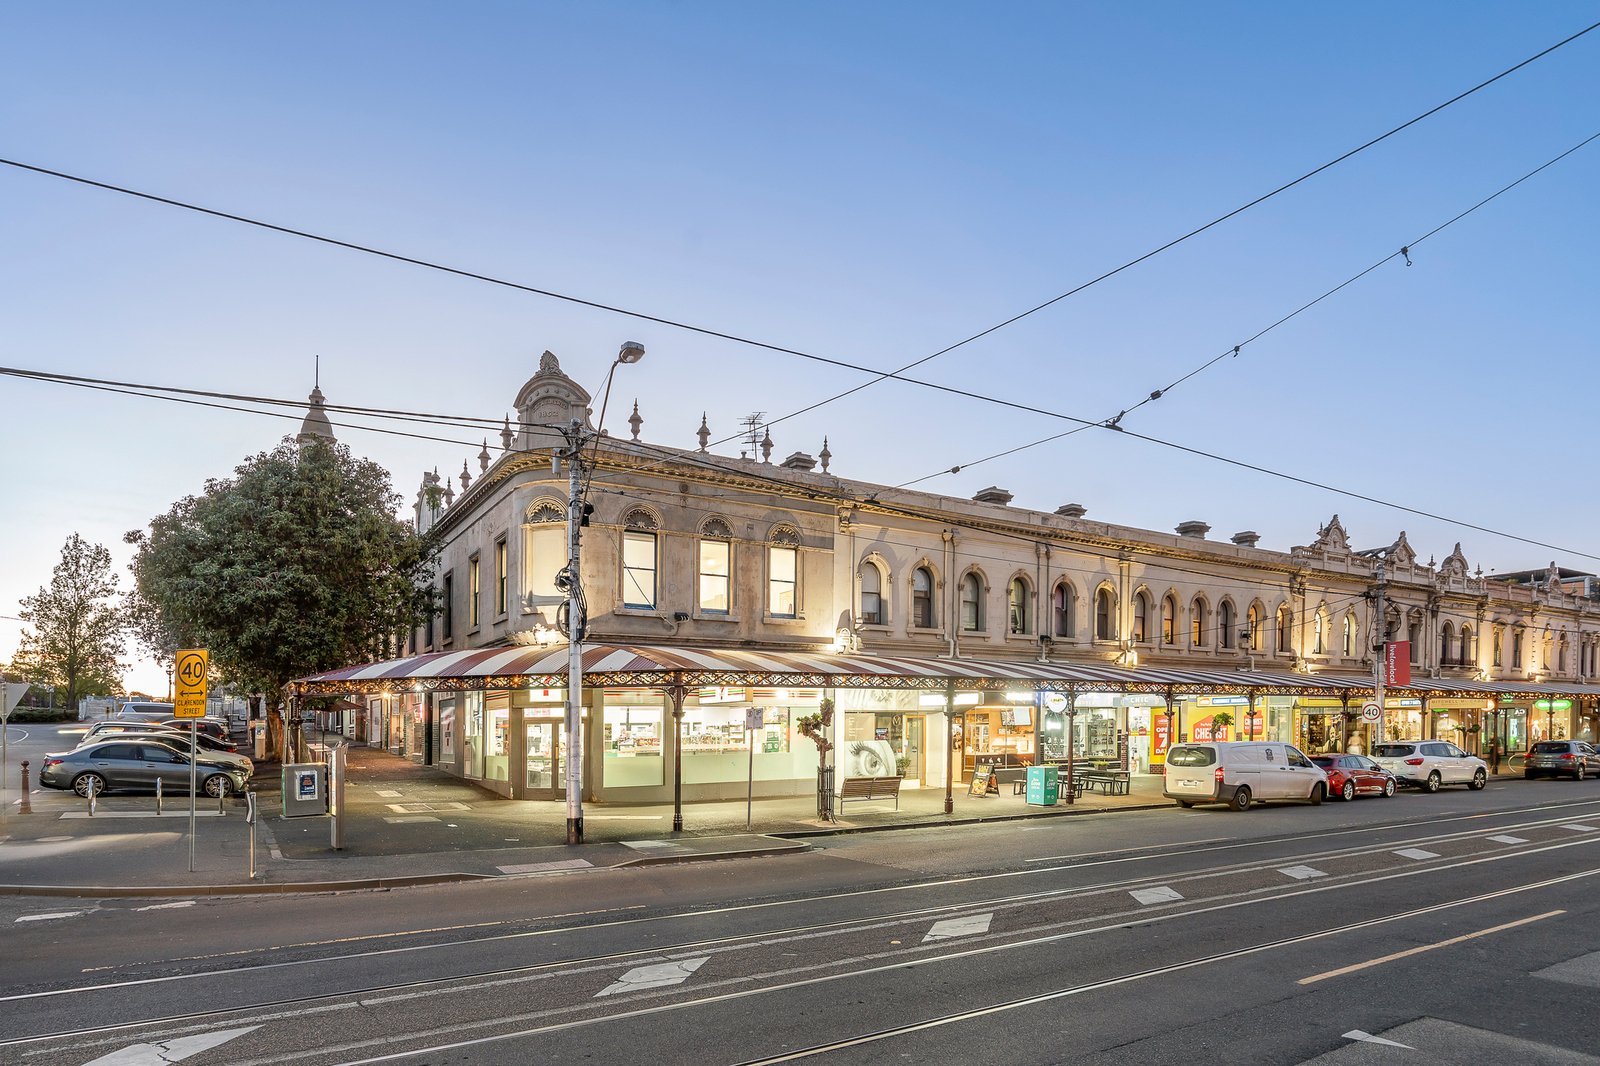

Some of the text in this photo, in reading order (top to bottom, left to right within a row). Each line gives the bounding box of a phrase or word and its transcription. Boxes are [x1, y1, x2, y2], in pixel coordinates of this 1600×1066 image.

[181, 661, 203, 679] 40
[1365, 708, 1378, 717] 40
[1195, 728, 1227, 739] CHEIST
